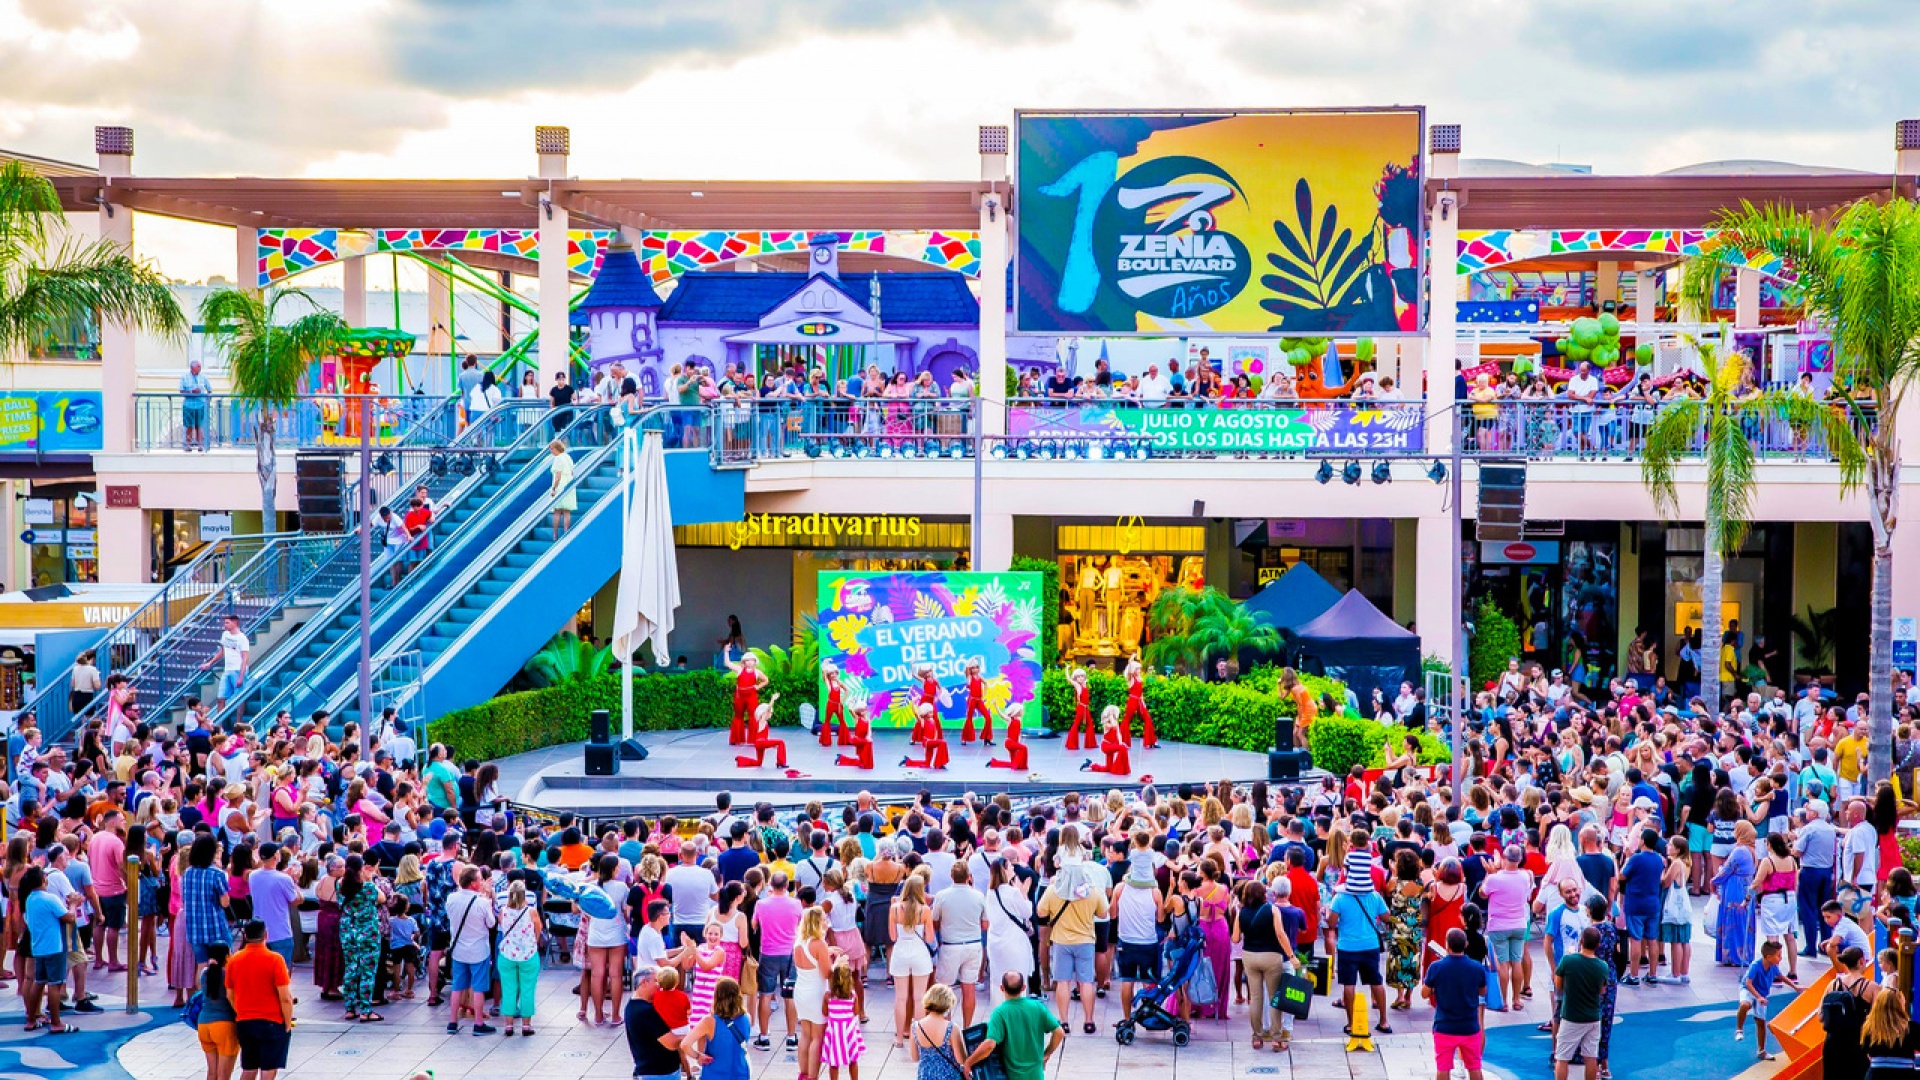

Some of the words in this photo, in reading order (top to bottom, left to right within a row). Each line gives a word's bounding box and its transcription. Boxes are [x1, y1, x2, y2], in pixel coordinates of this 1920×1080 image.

[1118, 235, 1235, 258] ZENIA
[1118, 258, 1237, 271] BOULEVARD
[1170, 282, 1231, 317] Años
[0, 424, 31, 435] RIZES
[1142, 413, 1193, 431] JULIO
[1196, 413, 1209, 428] Y
[1213, 413, 1290, 428] AGOSTO
[1182, 431, 1217, 446] LOS
[1221, 432, 1264, 446] DIAS
[1268, 432, 1330, 447] HASTA
[1334, 432, 1369, 447] LAS
[1372, 432, 1408, 447] 23H
[875, 628, 899, 646] EL
[900, 619, 983, 644] VERANO
[901, 644, 927, 662] DE
[930, 641, 956, 659] LA
